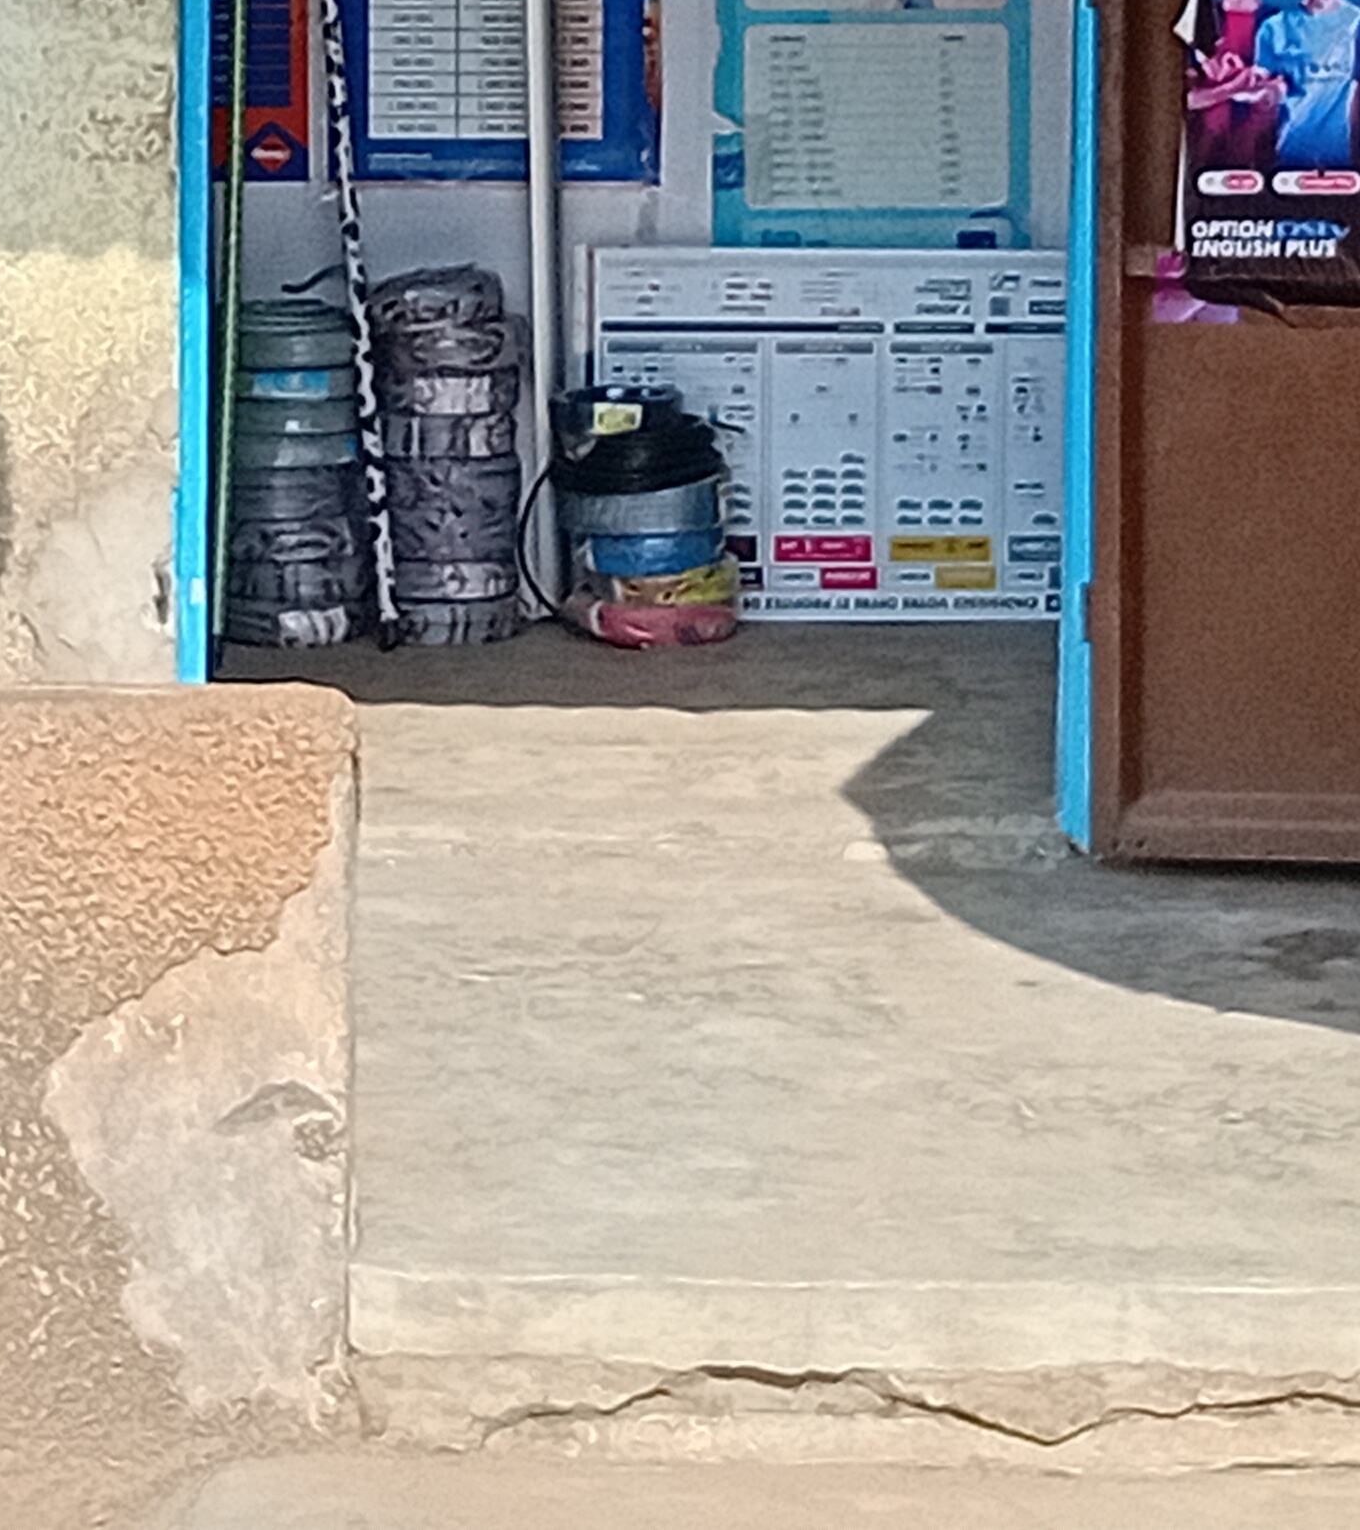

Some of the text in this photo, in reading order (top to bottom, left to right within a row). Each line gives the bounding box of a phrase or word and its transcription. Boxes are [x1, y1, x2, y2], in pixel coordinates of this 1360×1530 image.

[1191, 220, 1274, 239] OPTION
[1192, 238, 1338, 258] ENGLISH PLUS
